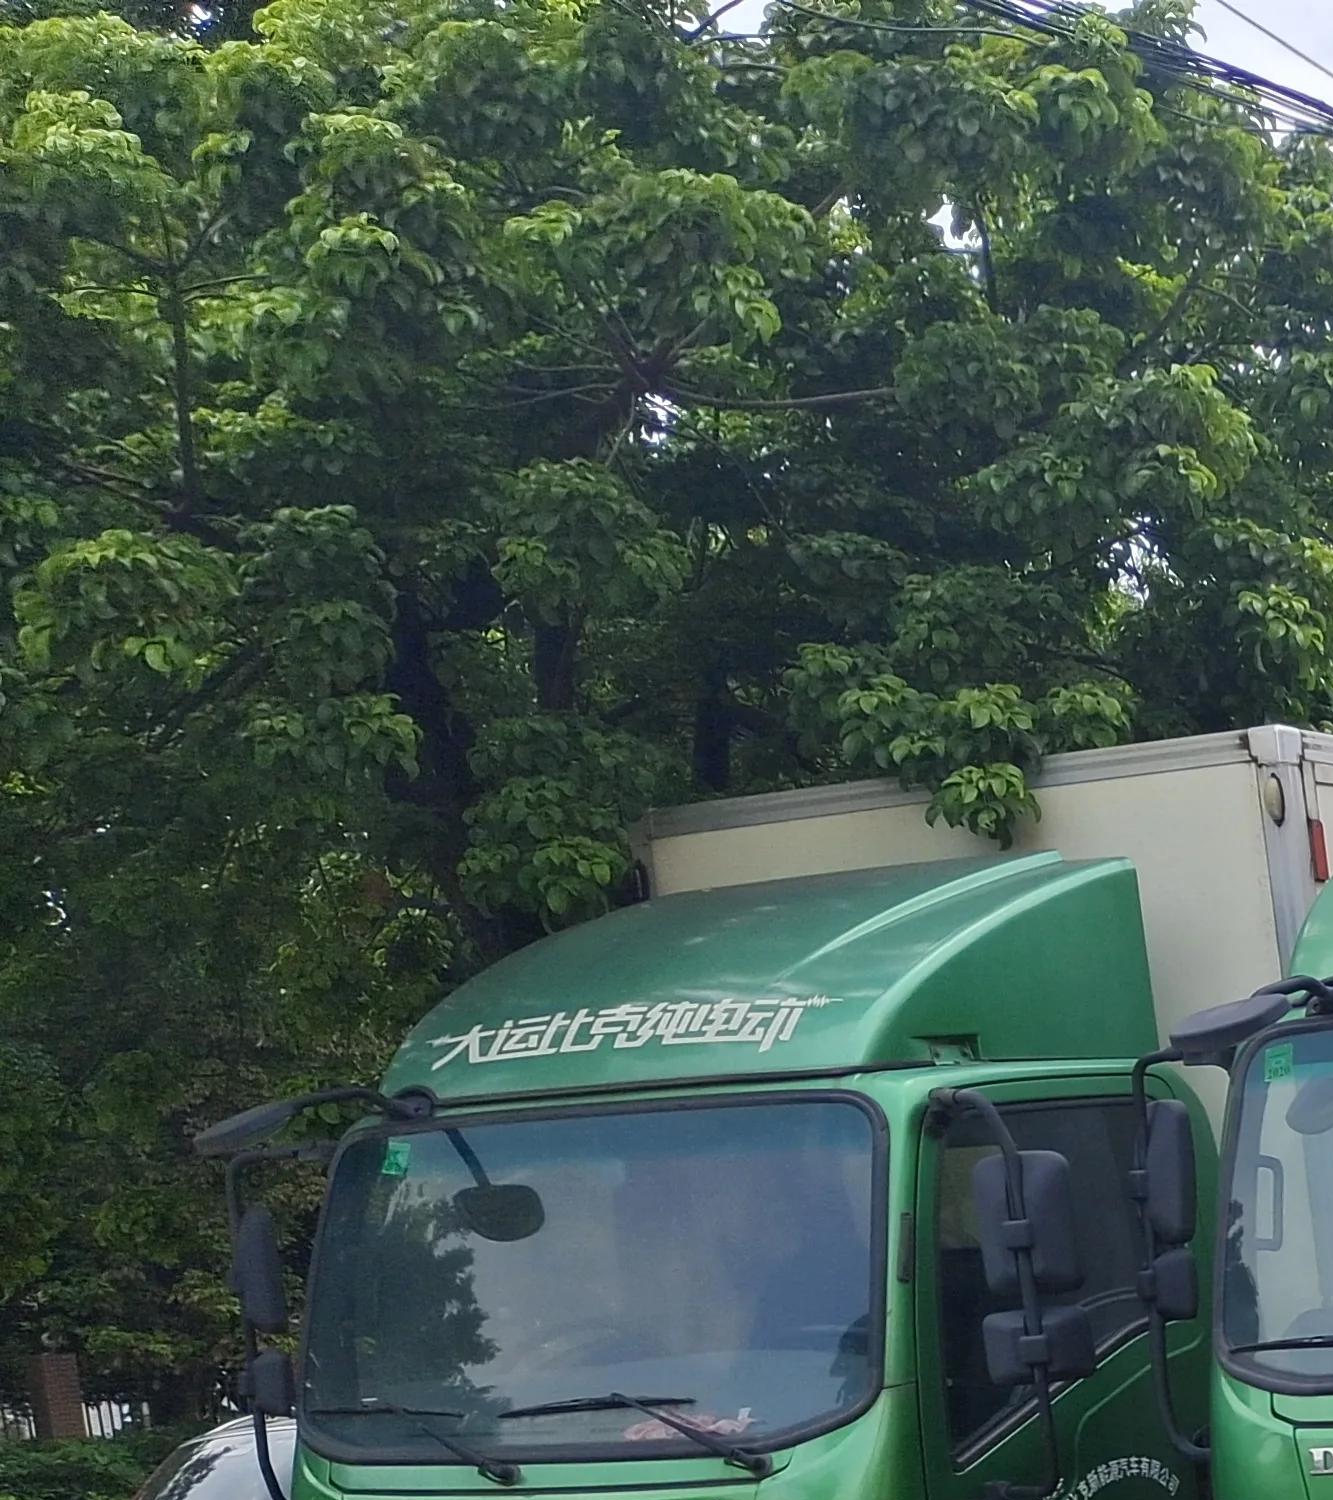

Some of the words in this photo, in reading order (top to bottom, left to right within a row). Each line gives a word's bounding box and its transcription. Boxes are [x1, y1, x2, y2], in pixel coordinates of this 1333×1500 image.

[432, 998, 806, 1071] 大运比克纯电动
